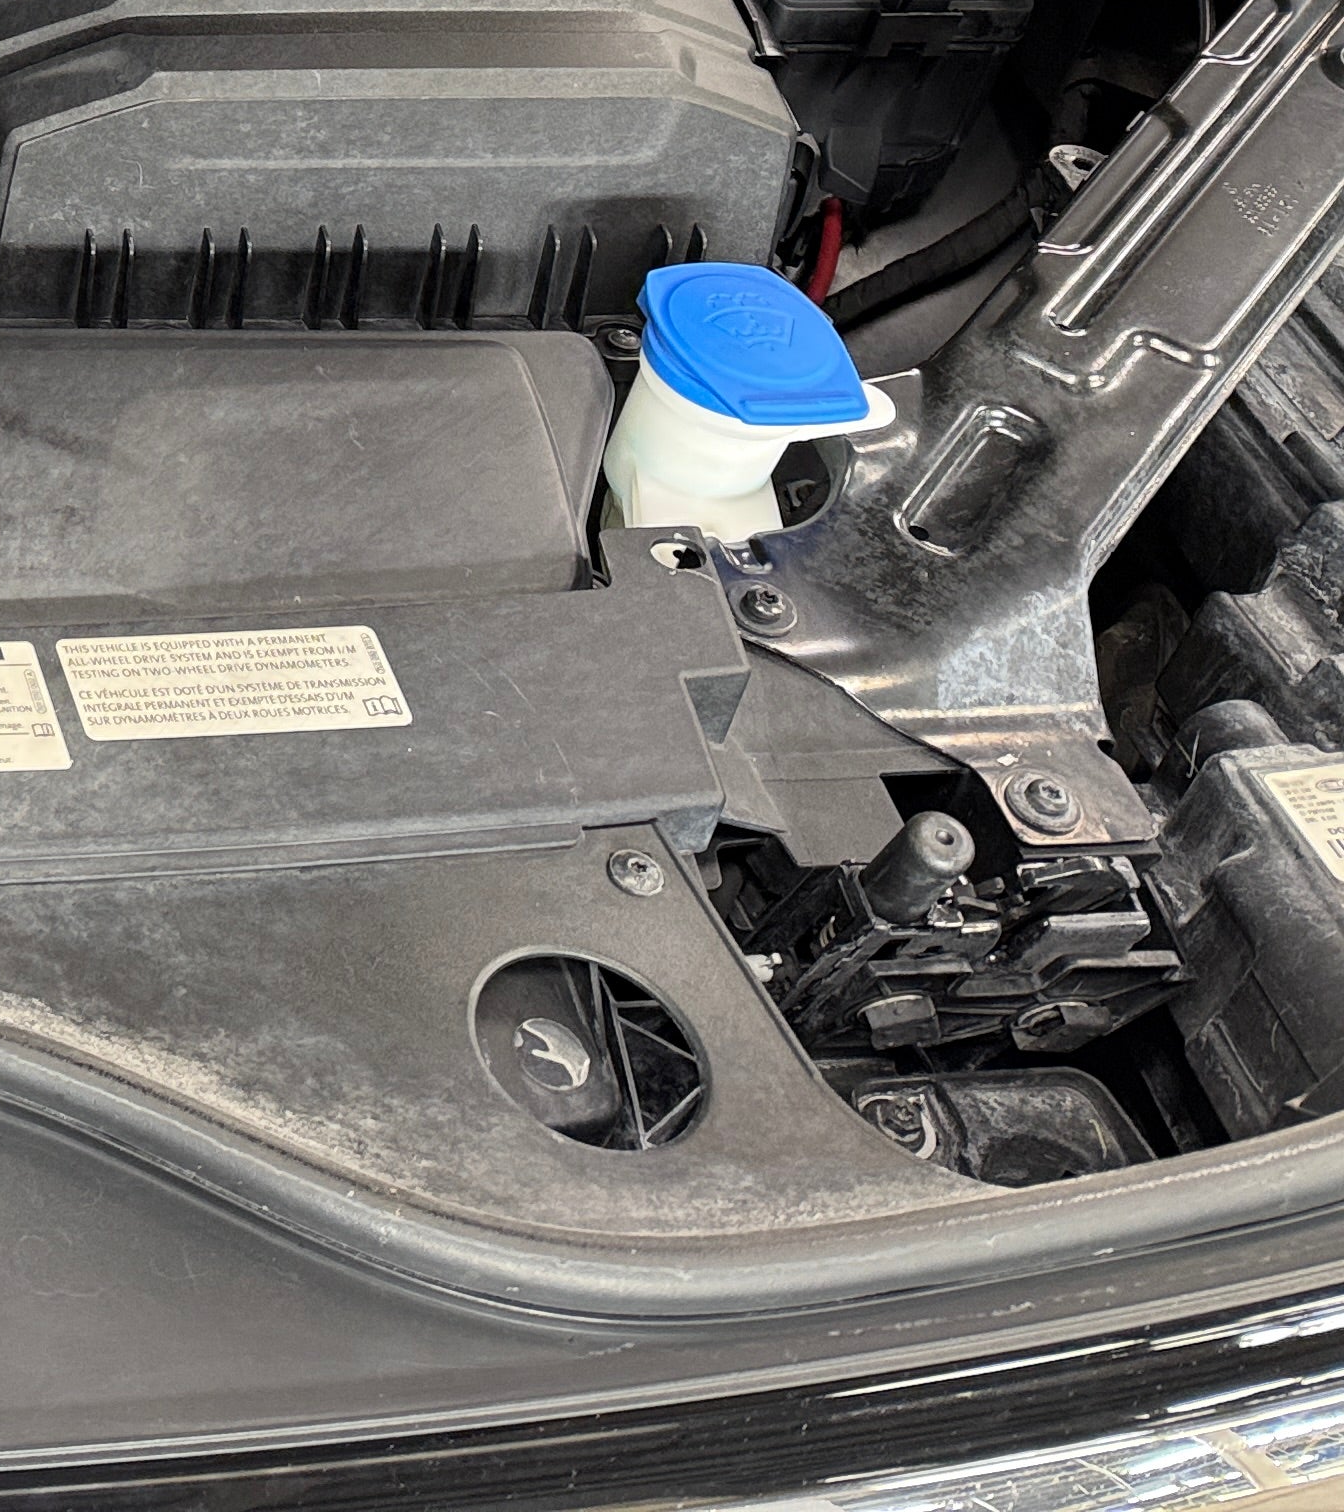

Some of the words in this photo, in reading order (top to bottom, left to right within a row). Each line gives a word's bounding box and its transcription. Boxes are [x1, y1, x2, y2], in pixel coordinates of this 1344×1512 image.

[62, 645, 89, 654] THIS
[91, 642, 138, 653] VEHICLE
[141, 641, 152, 651] IS
[154, 639, 211, 651] EQUIPPED
[212, 638, 244, 648] WITH
[247, 638, 256, 646] A
[258, 633, 326, 645] PERMANENT
[67, 655, 131, 667] ALL-WHEEL
[133, 653, 167, 664] DRIVE
[170, 652, 213, 663] SYSTEM
[215, 650, 242, 660] AND
[244, 649, 254, 659] IS
[256, 647, 300, 658] EXEMPT
[302, 646, 335, 656] FROM
[337, 644, 357, 654] I/M
[71, 668, 120, 679] TESTING
[122, 667, 142, 677] ON
[143, 665, 216, 677] TWO-WHEEL
[218, 662, 253, 673] DRIVE
[79, 690, 93, 700] CE
[152, 687, 171, 697] EST
[174, 684, 202, 696] DOTÉ
[205, 683, 236, 694] D'UN
[286, 679, 303, 689] DE
[303, 676, 387, 689] TRANSMISSION
[144, 698, 212, 710] PERMANENT
[213, 697, 226, 707] ET
[278, 691, 324, 704] D'ESSAIS
[87, 715, 115, 726] SUR
[219, 709, 251, 720] DEUX
[253, 708, 291, 718] ROUES
[293, 705, 351, 716] MOTRICES.
